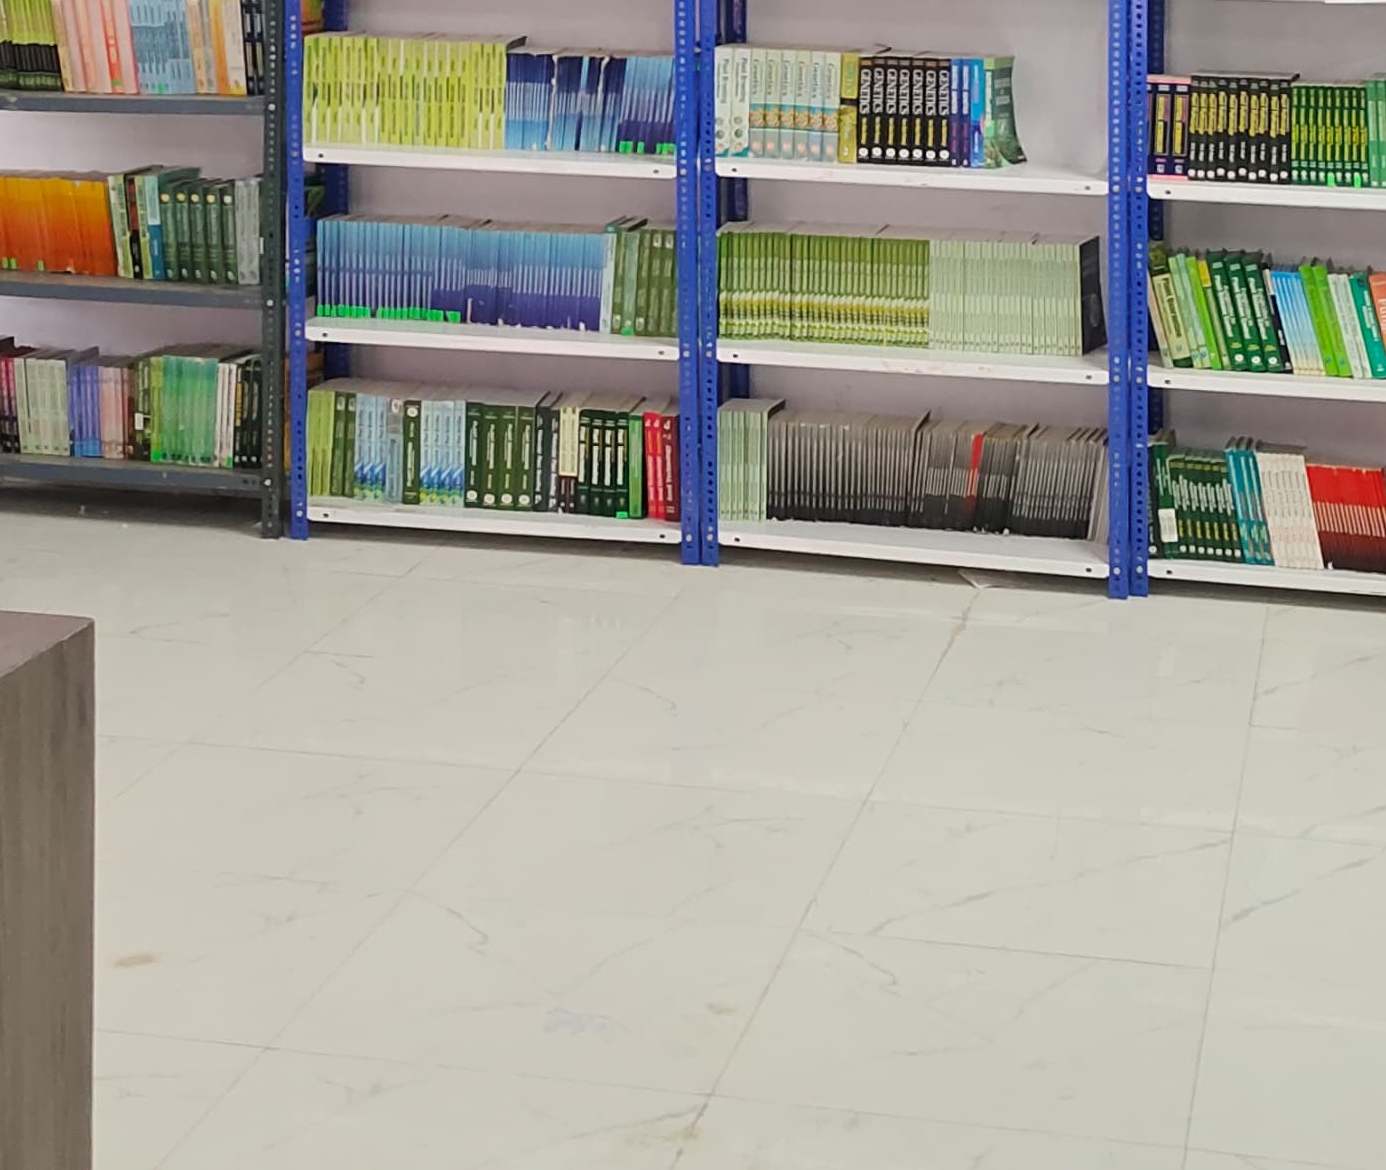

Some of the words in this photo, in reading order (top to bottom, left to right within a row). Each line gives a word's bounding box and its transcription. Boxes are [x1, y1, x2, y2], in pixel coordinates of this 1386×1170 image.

[859, 69, 871, 114] GENETICS
[873, 68, 884, 113] GENETICS
[886, 68, 898, 114] GENETICS
[899, 69, 910, 115] GENETICS
[912, 69, 924, 115] GENETICS
[925, 70, 937, 116] GENETICS
[939, 70, 950, 116] GENETICS
